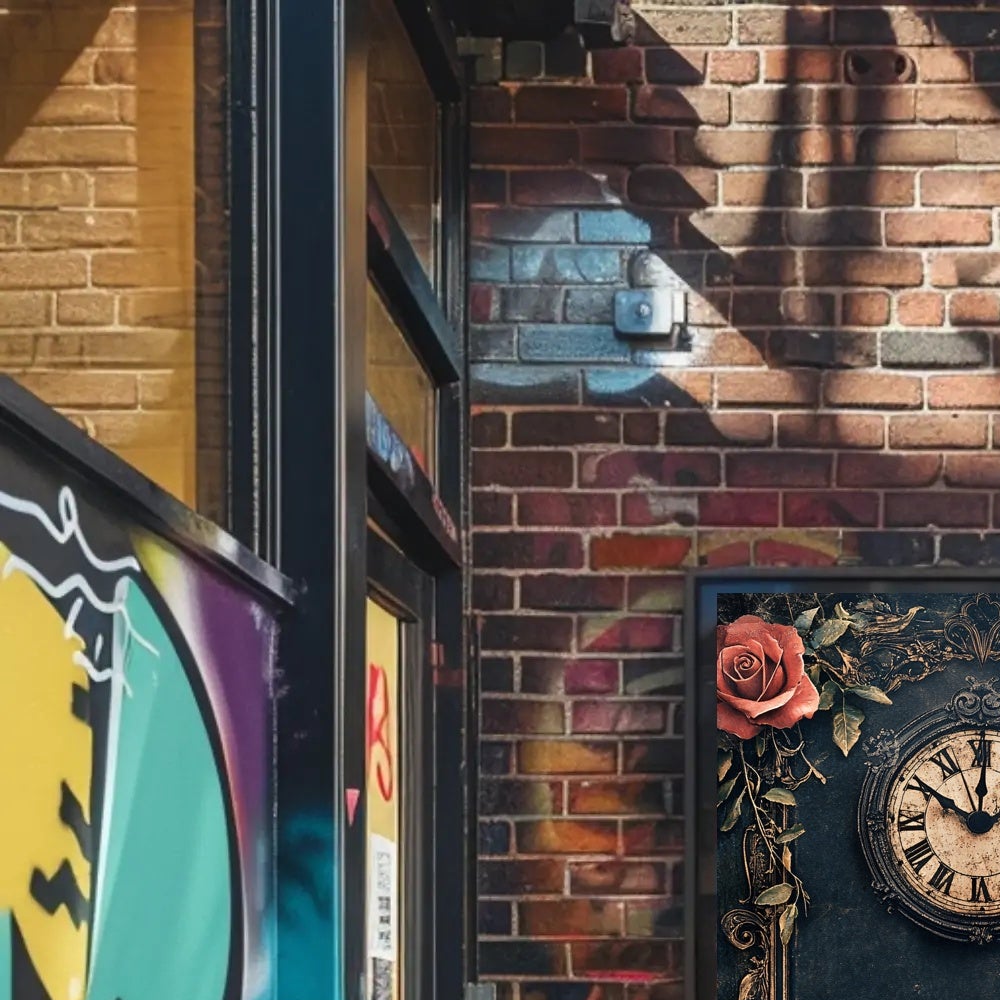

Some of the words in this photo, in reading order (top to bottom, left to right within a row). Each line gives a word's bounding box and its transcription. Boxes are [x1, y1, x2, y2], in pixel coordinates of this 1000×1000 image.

[929, 746, 961, 780] XI
[898, 810, 926, 832] IX
[904, 839, 935, 875] VIII
[927, 861, 954, 897] VII
[970, 876, 993, 903] VI
